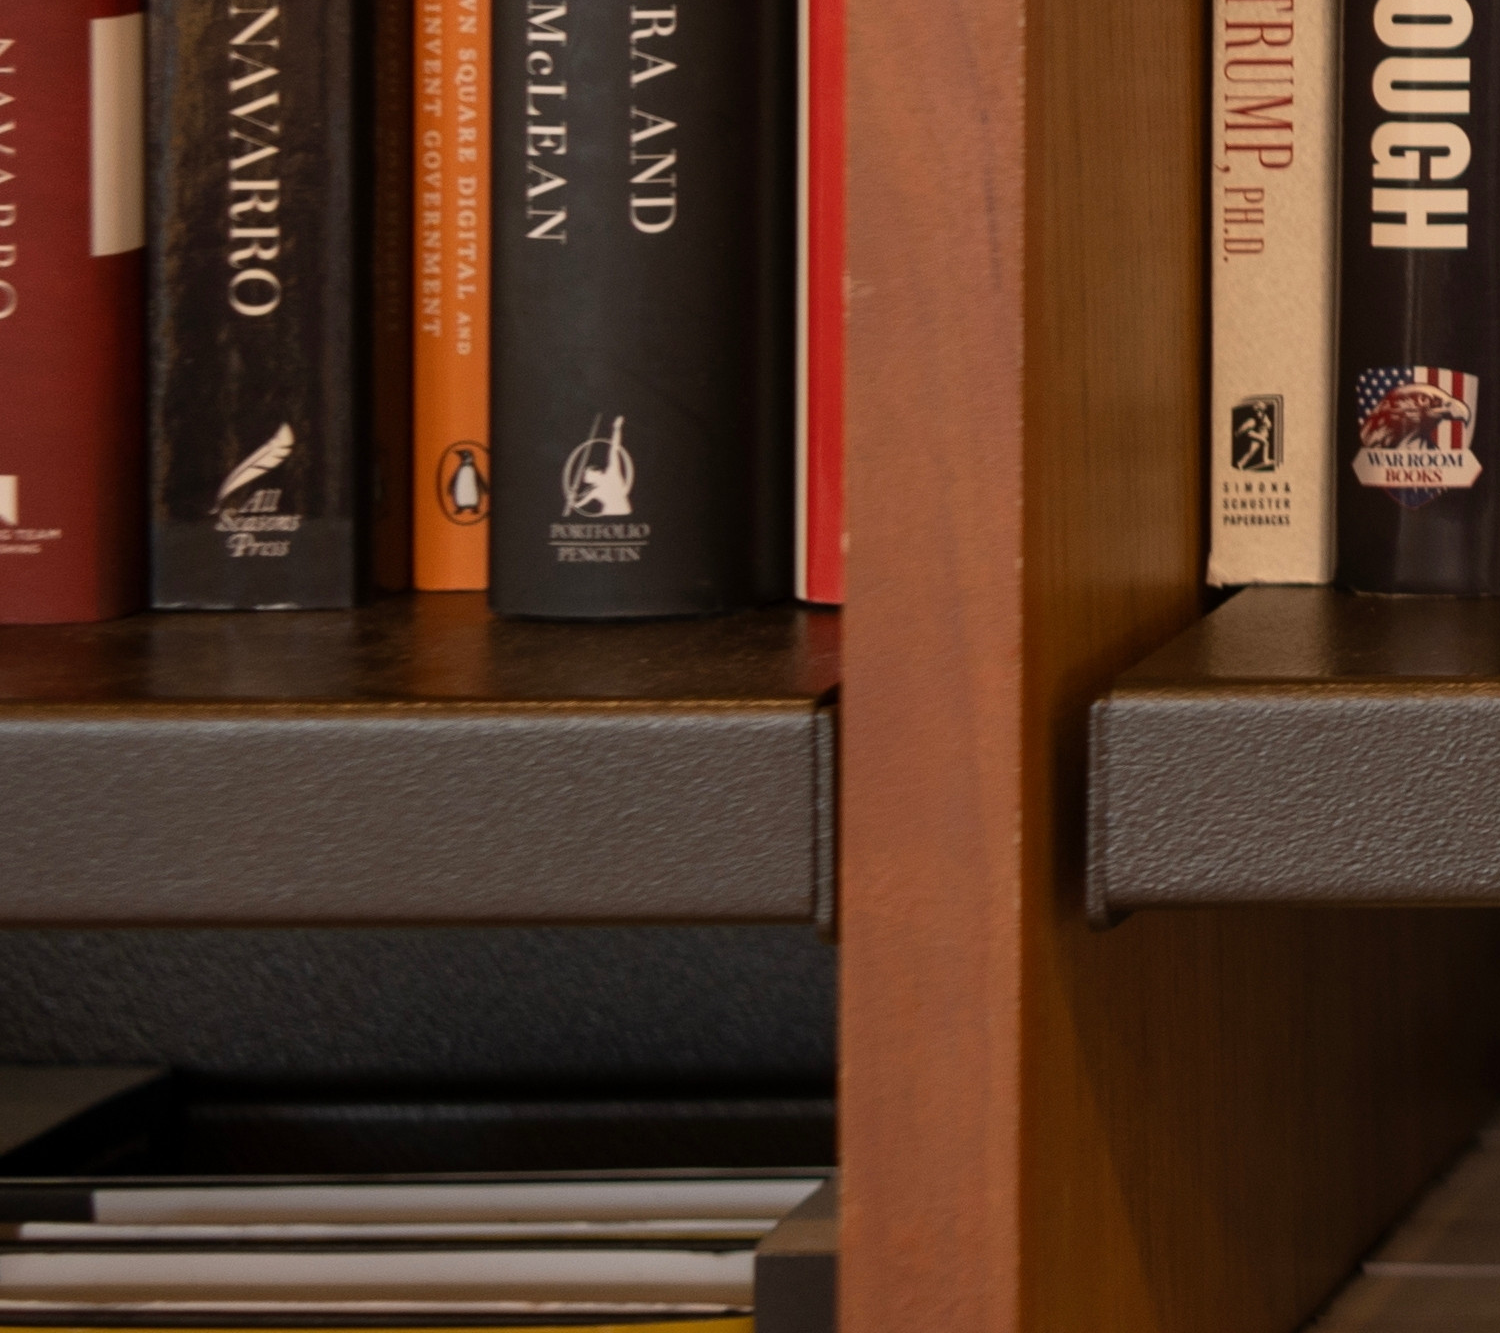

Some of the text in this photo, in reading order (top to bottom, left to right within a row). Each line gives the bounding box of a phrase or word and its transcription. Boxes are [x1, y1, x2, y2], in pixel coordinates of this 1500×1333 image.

[454, 45, 478, 163] SQUARE
[525, 0, 569, 245] McLEAN
[226, 6, 284, 318] NAVARRO
[629, 103, 680, 235] AND
[422, 129, 443, 339] GOVERNMENT
[1221, 186, 1265, 264] PH.D.
[456, 175, 478, 300] DIGITAL
[1366, 450, 1465, 469] WAR ROOM
[1223, 482, 1278, 494] SIMON
[1384, 467, 1444, 485] BOOKS
[1223, 498, 1291, 510] SCHUSTER
[550, 522, 651, 540] PORTFOLIO
[1223, 514, 1291, 526] PAPERBACKS
[225, 534, 291, 558] Press
[557, 547, 642, 563] PENGUIN
